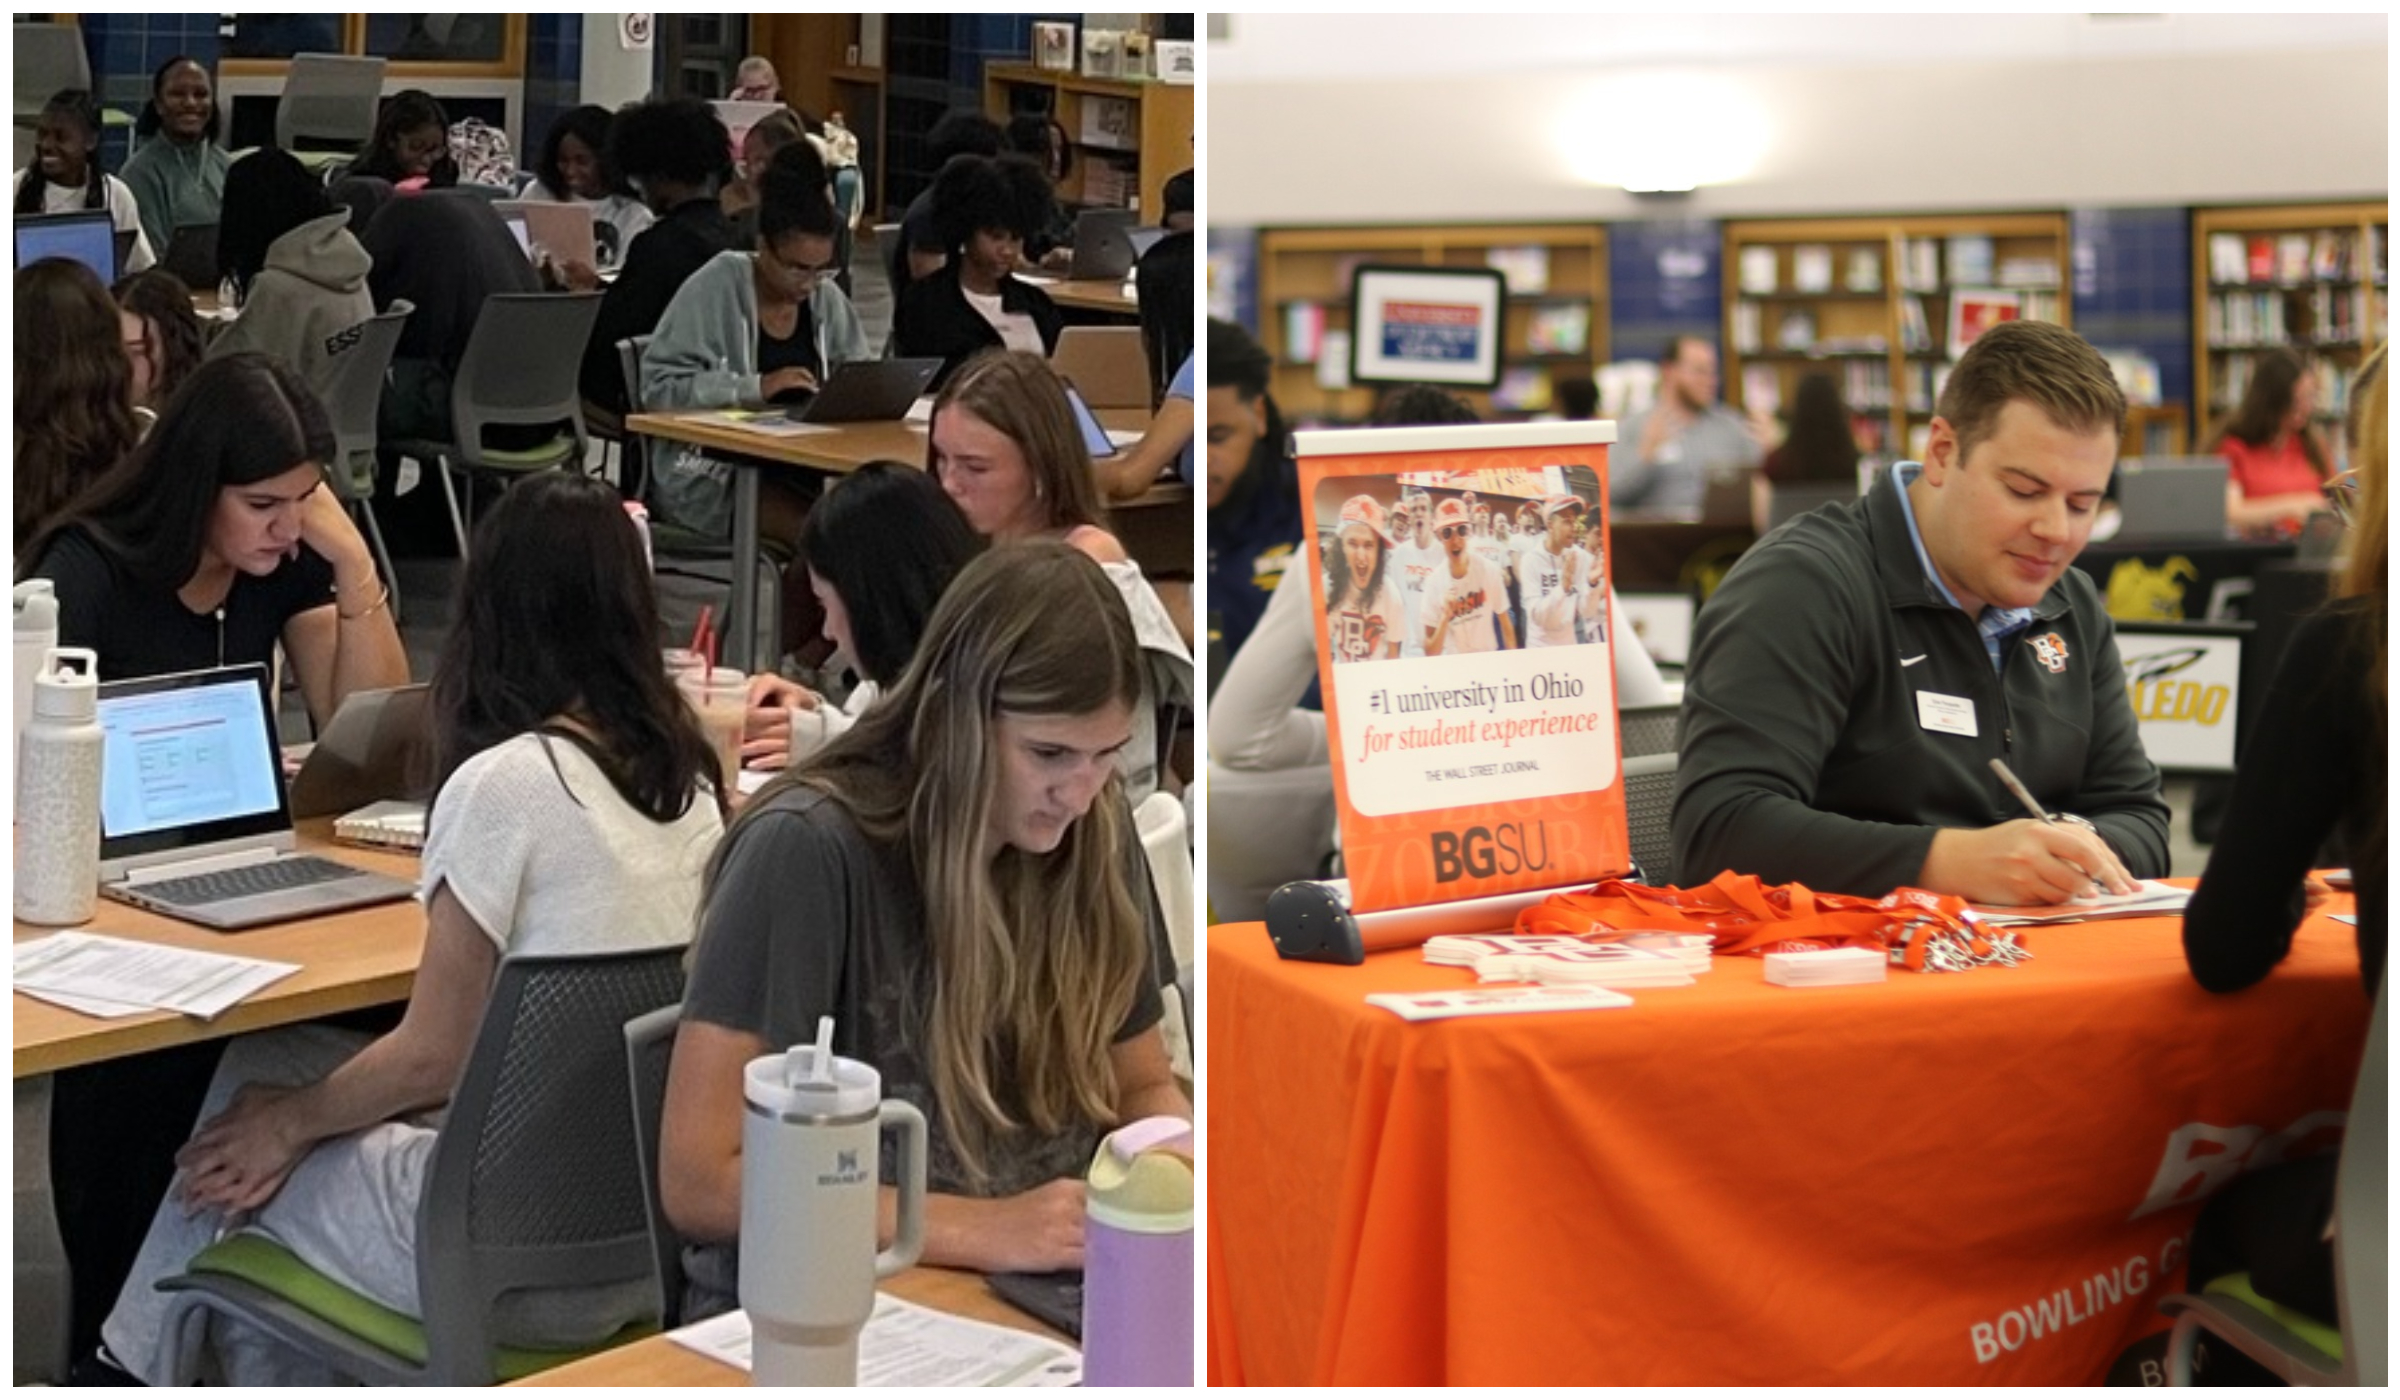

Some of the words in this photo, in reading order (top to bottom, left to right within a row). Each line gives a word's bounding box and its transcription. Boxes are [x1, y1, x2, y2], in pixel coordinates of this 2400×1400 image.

[325, 323, 364, 356] ESS
[1370, 689, 1391, 714] #1
[1397, 680, 1498, 713] university
[1503, 678, 1525, 703] in
[1531, 672, 1584, 701] Ohio
[2126, 679, 2230, 727] LEDO
[1358, 724, 1394, 763] for
[1399, 719, 1476, 750] student
[1481, 710, 1599, 748] experience
[1425, 769, 1442, 782] THE
[1443, 766, 1468, 780] WALL
[1469, 763, 1498, 778] STREET
[1500, 760, 1540, 775] JOURNAL
[1969, 1254, 2149, 1365] BOWLING
